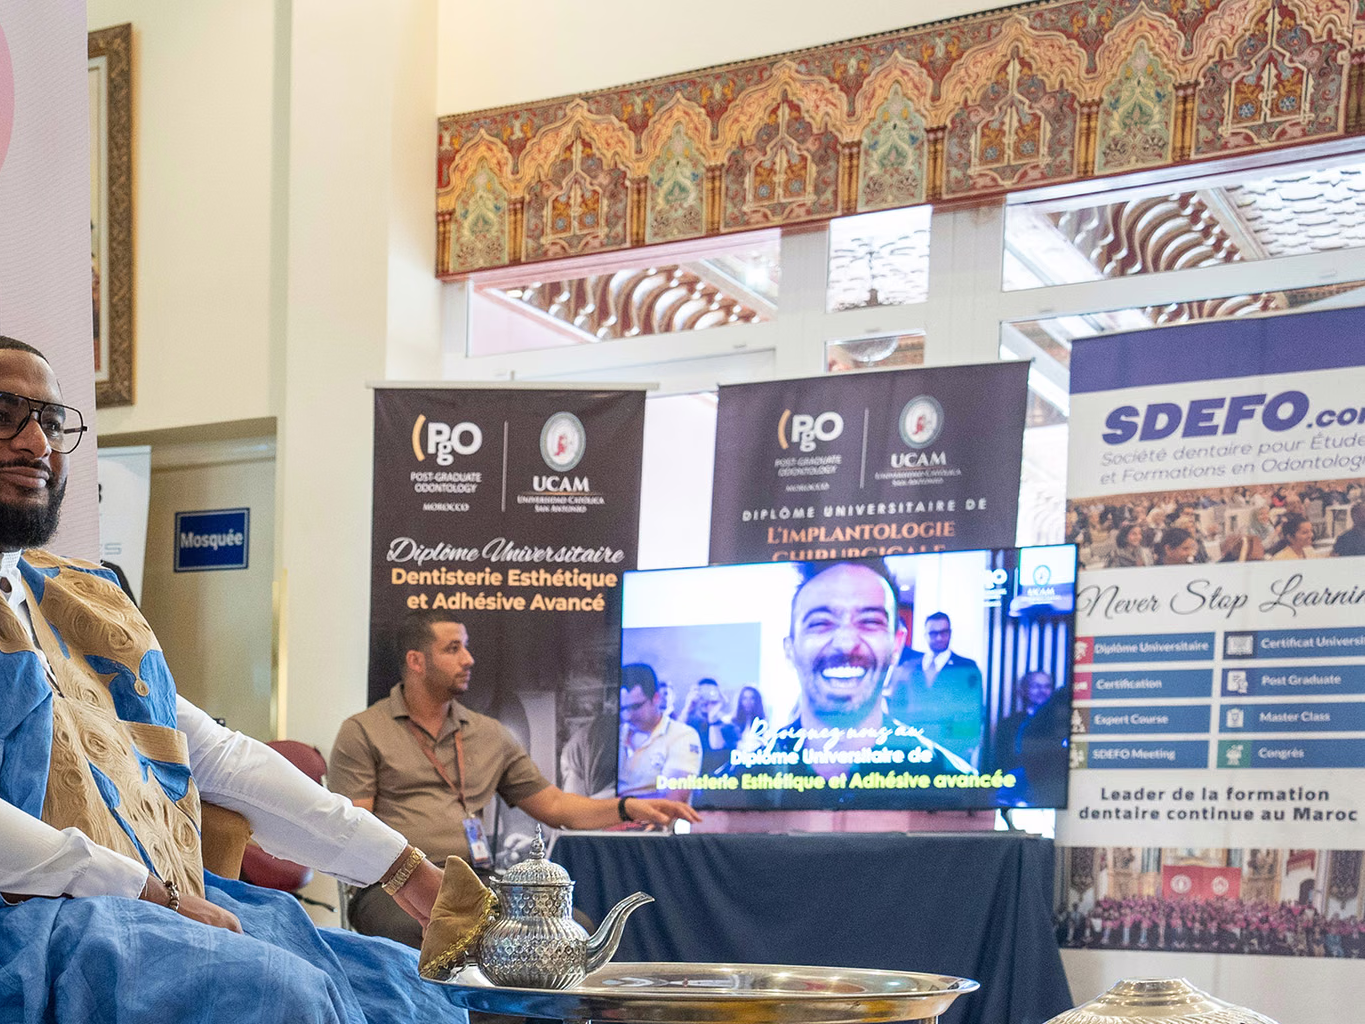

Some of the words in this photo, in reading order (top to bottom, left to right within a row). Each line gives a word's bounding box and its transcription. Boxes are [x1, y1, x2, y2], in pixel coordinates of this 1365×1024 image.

[1101, 446, 1167, 468] Société
[1174, 440, 1253, 461] dentaire
[1257, 440, 1306, 459] pour
[1310, 432, 1365, 451] Étude
[891, 452, 947, 468] UCAM
[1100, 472, 1116, 485] et
[1122, 465, 1226, 484] Formations
[1232, 461, 1255, 475] en
[1261, 452, 1365, 473] Odontologi
[414, 483, 478, 494] ODONTOLOGY
[532, 476, 590, 492] UCAM
[422, 503, 470, 512] MOROCCO
[742, 505, 815, 522] DIPLÔME
[823, 500, 956, 518] UNIVERSITAIRE
[966, 498, 988, 512] DE
[180, 528, 244, 551] Mosquée
[386, 536, 480, 566] Diplôme
[482, 536, 625, 565] Universitaire
[391, 567, 503, 587] Dentisterie
[507, 568, 618, 591] Esthétique
[406, 595, 428, 610] et
[432, 591, 526, 612] Adhésive
[530, 592, 605, 612] Avancé
[1075, 584, 1160, 620] Never
[1169, 578, 1250, 619] Stop
[1258, 573, 1365, 617] Learnin
[1140, 640, 1211, 654] Universitaire
[1261, 636, 1314, 650] Certificat
[1316, 634, 1365, 648] Universi
[1096, 677, 1162, 690] Certification
[1261, 676, 1286, 687] Post
[1288, 674, 1342, 686] Graduate
[1094, 714, 1130, 728] Expert
[1130, 712, 1169, 725] Course
[1259, 712, 1298, 723] Master
[1300, 710, 1332, 722] Class
[730, 748, 799, 768] Diplôme
[802, 747, 904, 766] Universitaire
[908, 746, 933, 764] de
[1092, 748, 1130, 760] SDEFO
[1131, 748, 1176, 762] Meeting
[656, 774, 739, 790] Dentisterie
[741, 773, 825, 793] Esthétique
[828, 774, 847, 789] et
[849, 770, 930, 789] Adhésive
[932, 769, 1016, 789] avancée
[1100, 786, 1166, 802] Leader
[1172, 786, 1196, 802] de
[1202, 786, 1219, 802] la
[1225, 786, 1330, 802] formation
[1079, 806, 1160, 820] dentaire
[1166, 807, 1254, 821] continue
[1260, 808, 1286, 822] au
[1293, 807, 1359, 822] Maroc
